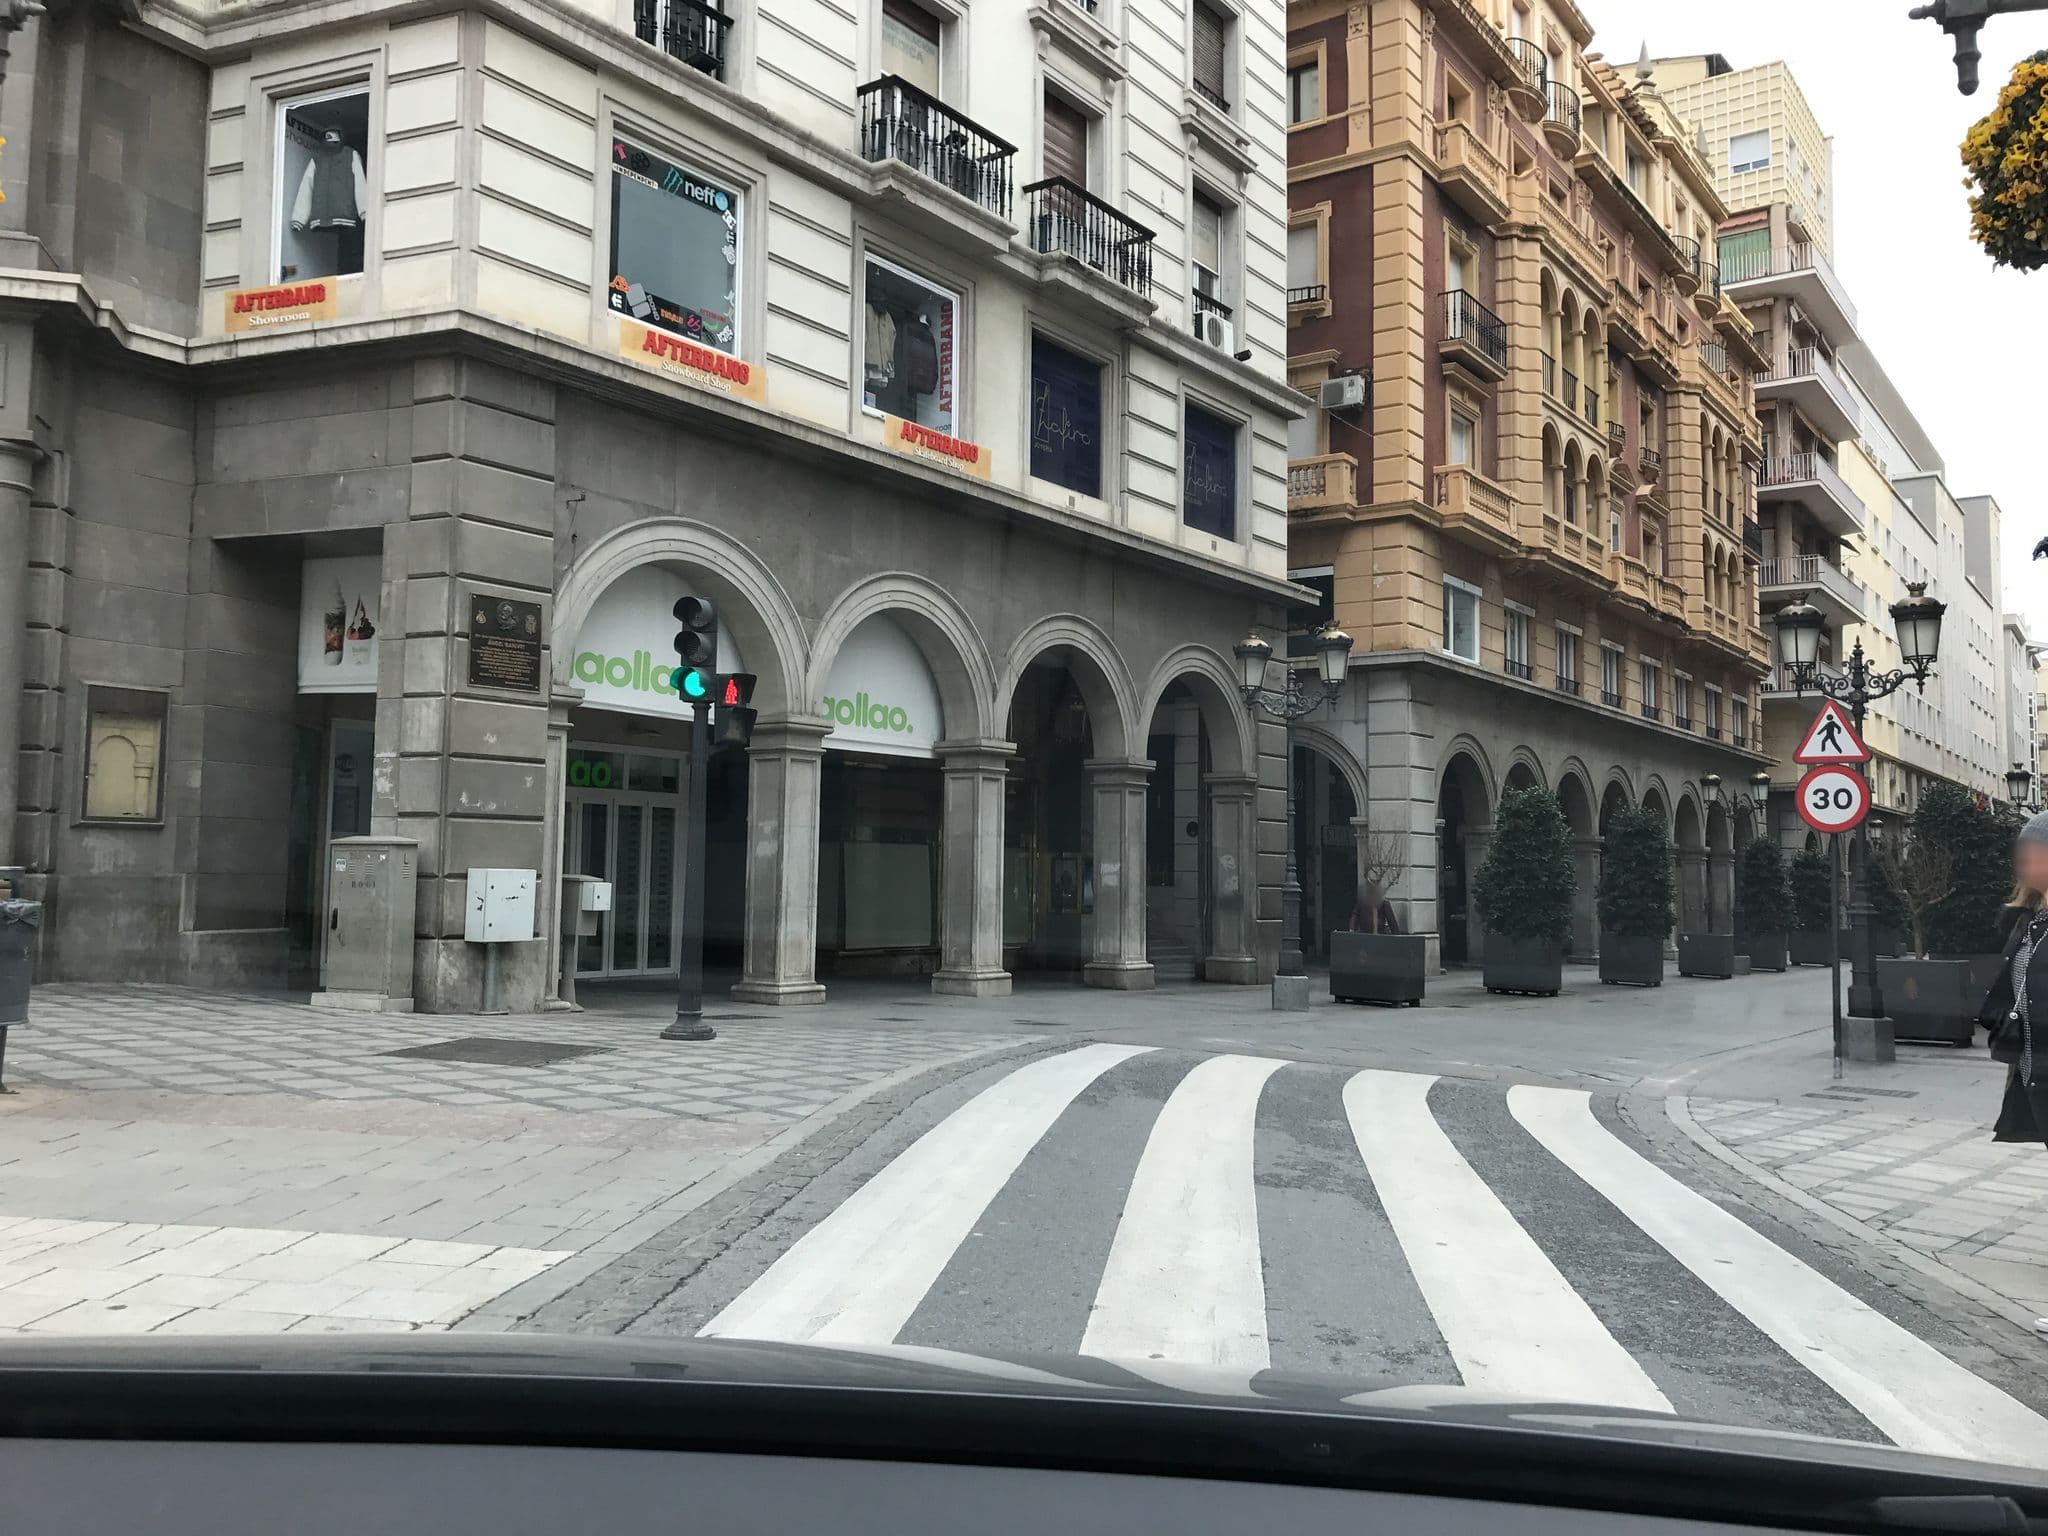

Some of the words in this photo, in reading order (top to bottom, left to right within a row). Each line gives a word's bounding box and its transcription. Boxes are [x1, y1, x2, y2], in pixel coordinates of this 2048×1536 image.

[685, 180, 715, 206] neff
[234, 284, 326, 313] AFTERBANG
[249, 312, 310, 326] Showroom
[643, 330, 749, 385] AFTERBANG
[662, 360, 709, 384] Snowboard
[710, 375, 731, 393] Shop
[901, 421, 978, 463] AFTERBANG
[914, 446, 948, 465] Skateboard
[947, 457, 964, 472] Shop
[570, 649, 677, 696] aolla
[1812, 788, 1853, 810] 30
